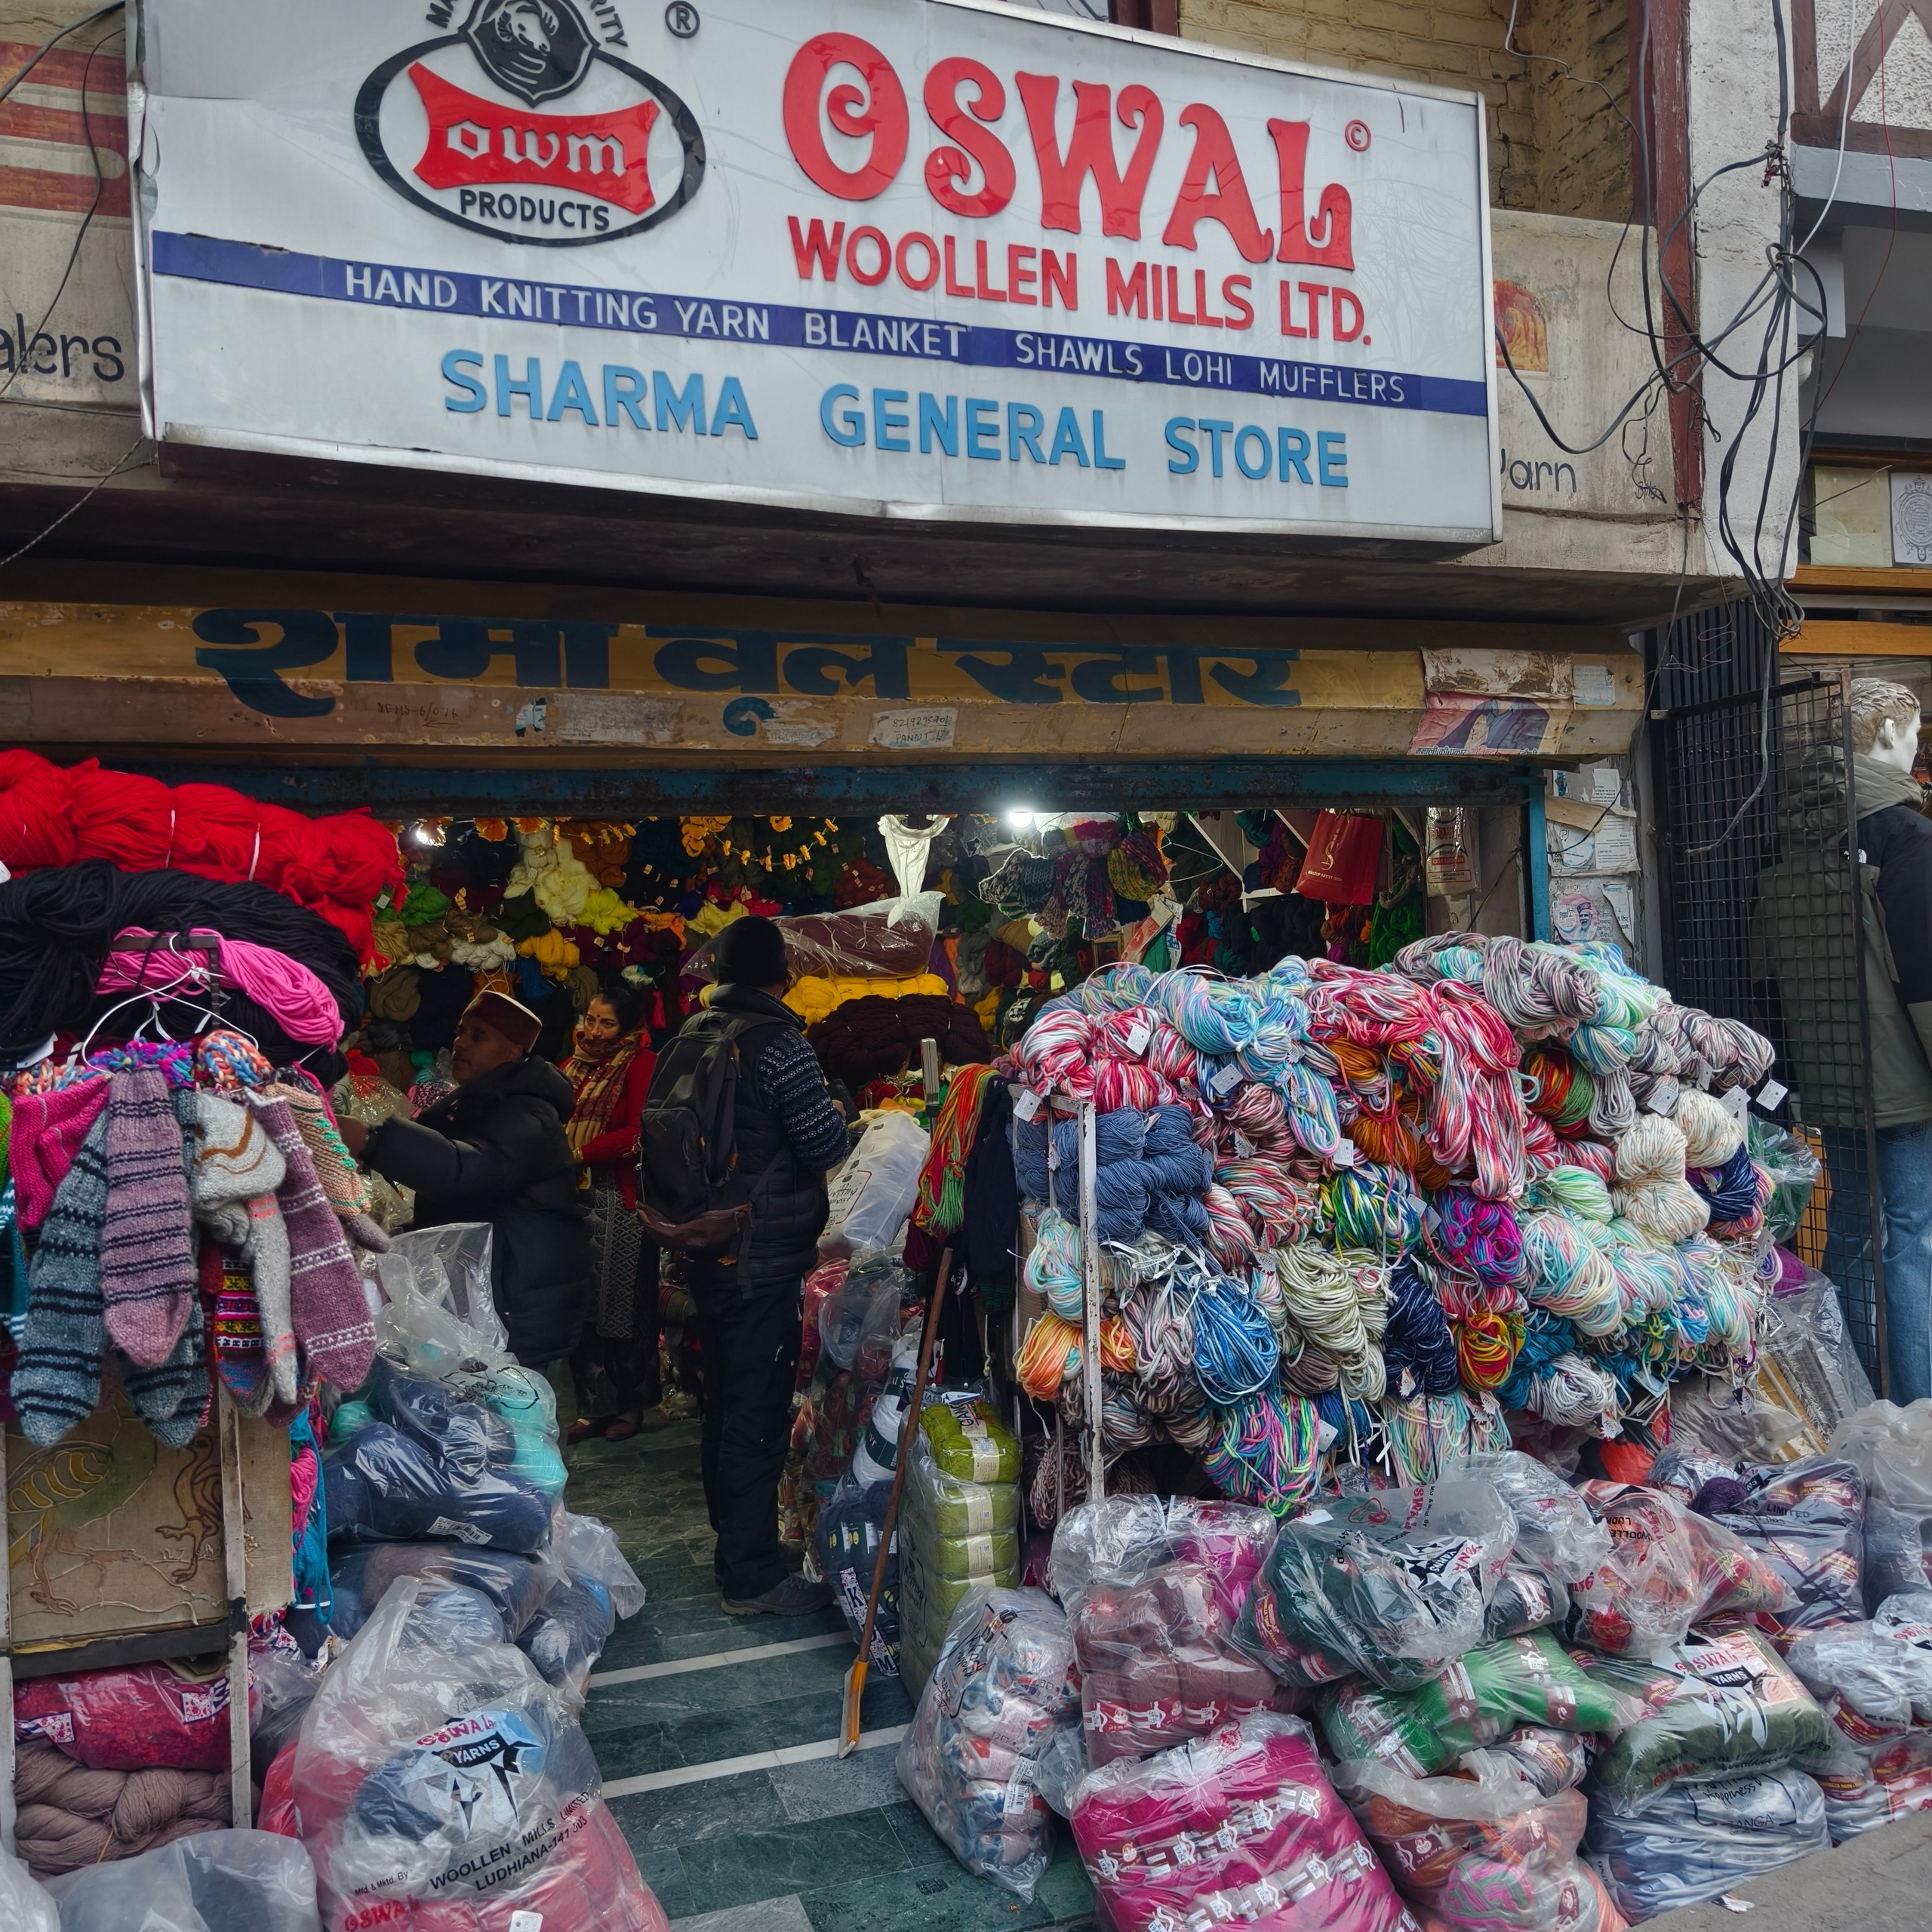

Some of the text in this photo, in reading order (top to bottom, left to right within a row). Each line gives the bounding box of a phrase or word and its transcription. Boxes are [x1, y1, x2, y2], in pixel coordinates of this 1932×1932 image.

[783, 31, 1356, 272] OSWAL
[460, 189, 610, 232] PRODUCTS
[787, 215, 1372, 346] WOOLLEN MILLS LTD.
[346, 264, 1404, 404] HAND KNITTING YARN BLANKET SHAWLS LOHI MUFFLERS
[441, 349, 1349, 488] SHARMA GENERAL STORE
[1766, 1503, 1810, 1518] LIMITED
[1711, 1669, 1747, 1686] YARNS
[417, 1713, 497, 1747] OSWAL
[453, 1738, 500, 1765] YARNS
[429, 1790, 590, 1890] WOOLLEN MILLS LIMITED
[398, 1870, 410, 1882] By
